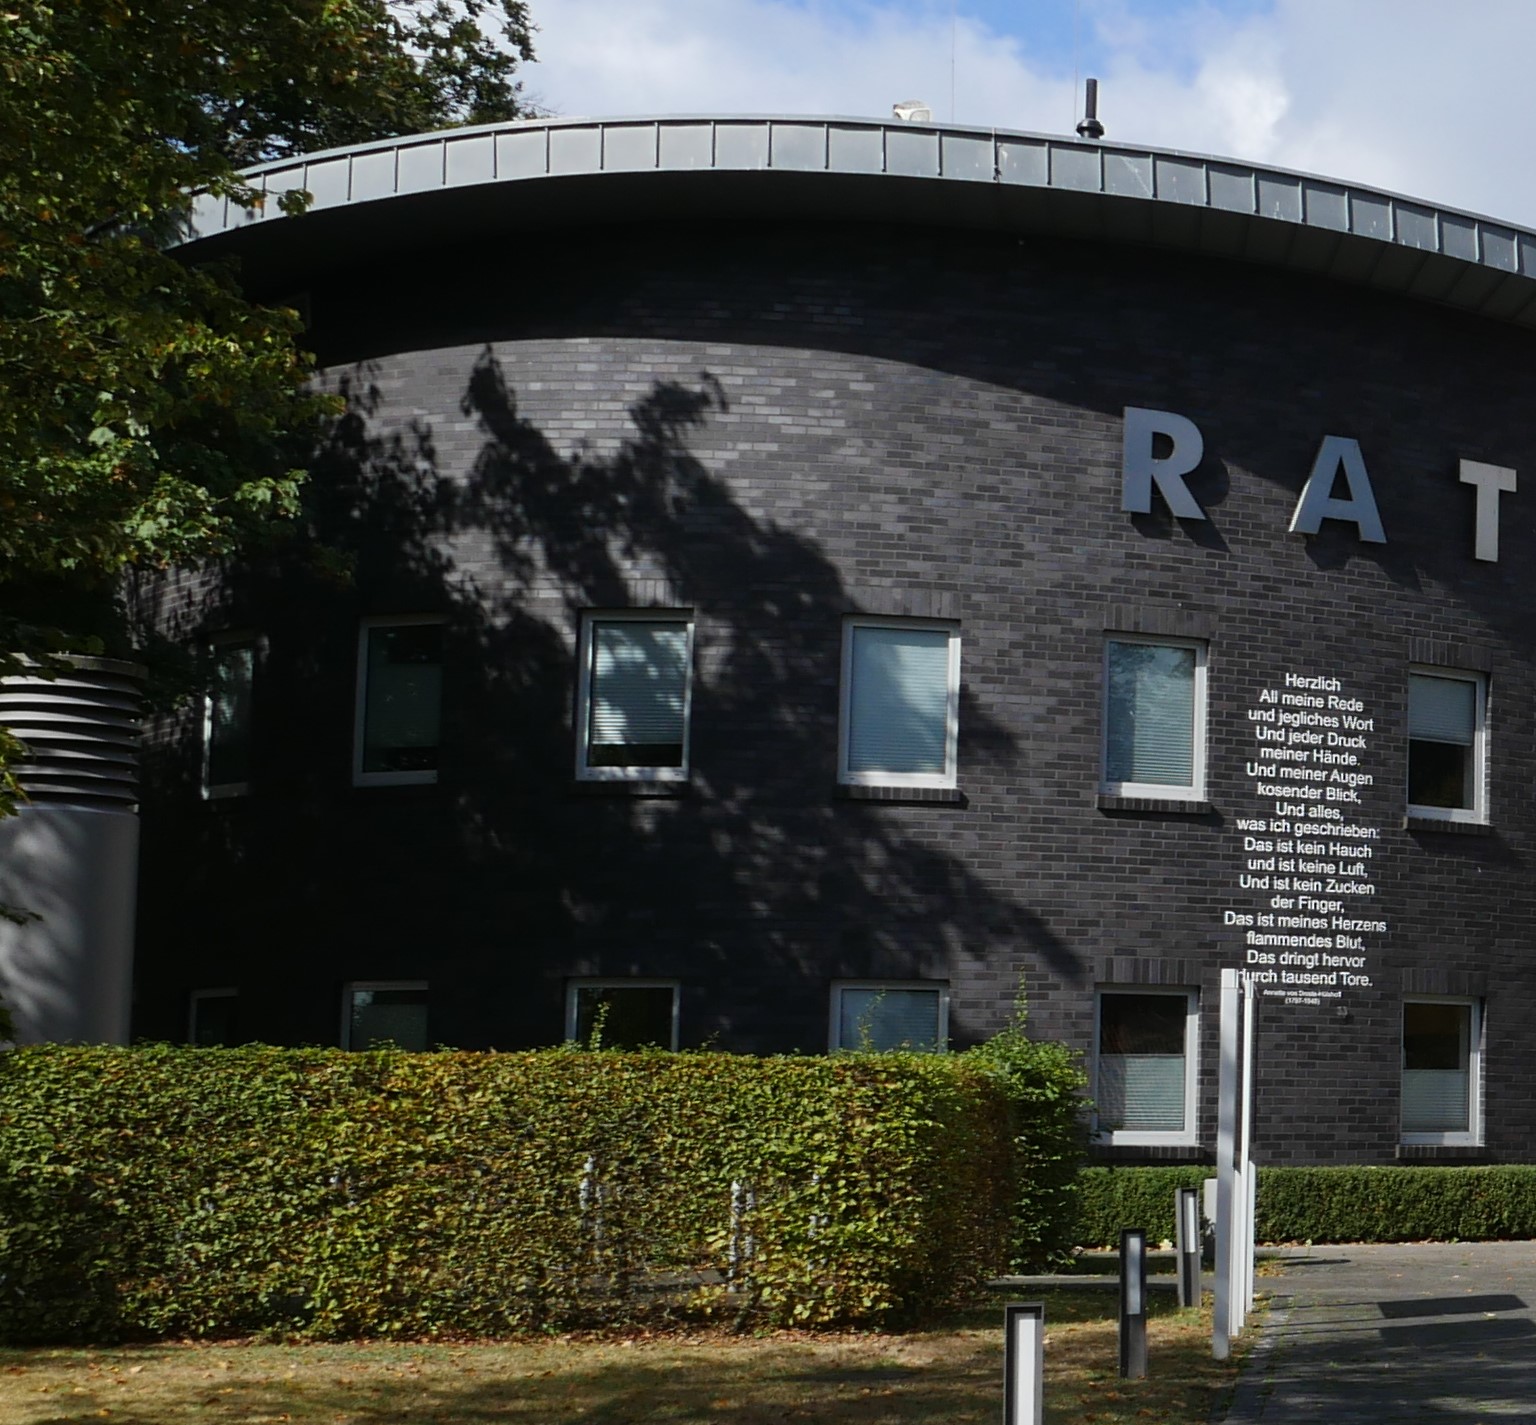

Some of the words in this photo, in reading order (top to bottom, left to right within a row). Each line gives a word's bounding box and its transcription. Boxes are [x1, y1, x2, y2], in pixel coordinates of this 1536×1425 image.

[1286, 673, 1340, 691] Herzlich
[1259, 689, 1278, 703] All
[1282, 693, 1324, 708] meine
[1328, 696, 1363, 711] Rede
[1249, 709, 1275, 721] und
[1278, 710, 1339, 727] jegliches
[1343, 715, 1373, 731] Wort
[1256, 726, 1285, 741] Und
[1288, 731, 1324, 745] jeder
[1328, 732, 1366, 748] Druck
[1261, 748, 1309, 761] meiner
[1247, 762, 1276, 777] Und
[1280, 767, 1328, 781] meiner
[1329, 769, 1372, 787] Augen
[1257, 782, 1323, 799] kosender
[1326, 787, 1361, 804] Blick,
[1276, 802, 1304, 816] Und
[1237, 820, 1266, 831] was
[1270, 819, 1290, 832] ich
[1245, 837, 1273, 852] Das
[1277, 839, 1293, 853] ist
[1297, 841, 1325, 854] kein
[1330, 842, 1372, 858] Hauch
[1248, 858, 1274, 870] und
[1279, 858, 1295, 872] ist
[1299, 860, 1335, 874] keine
[1339, 862, 1367, 877] Luft,
[1240, 875, 1269, 889] Und
[1274, 877, 1290, 890] ist
[1293, 878, 1322, 891] kein
[1325, 879, 1374, 894] Zucken
[1271, 895, 1295, 908] der
[1299, 897, 1344, 913] Finger,
[1225, 911, 1253, 926] Das
[1258, 913, 1274, 926] ist
[1278, 916, 1327, 928] meines
[1332, 917, 1386, 932] Herzens
[1246, 931, 1332, 947] flammendes
[1336, 935, 1365, 951] Blut,
[1247, 950, 1275, 964] Das
[1280, 952, 1319, 969] dringt
[1323, 954, 1365, 967] hervor
[1282, 971, 1336, 984] tausend
[1340, 972, 1372, 986] Tore.
